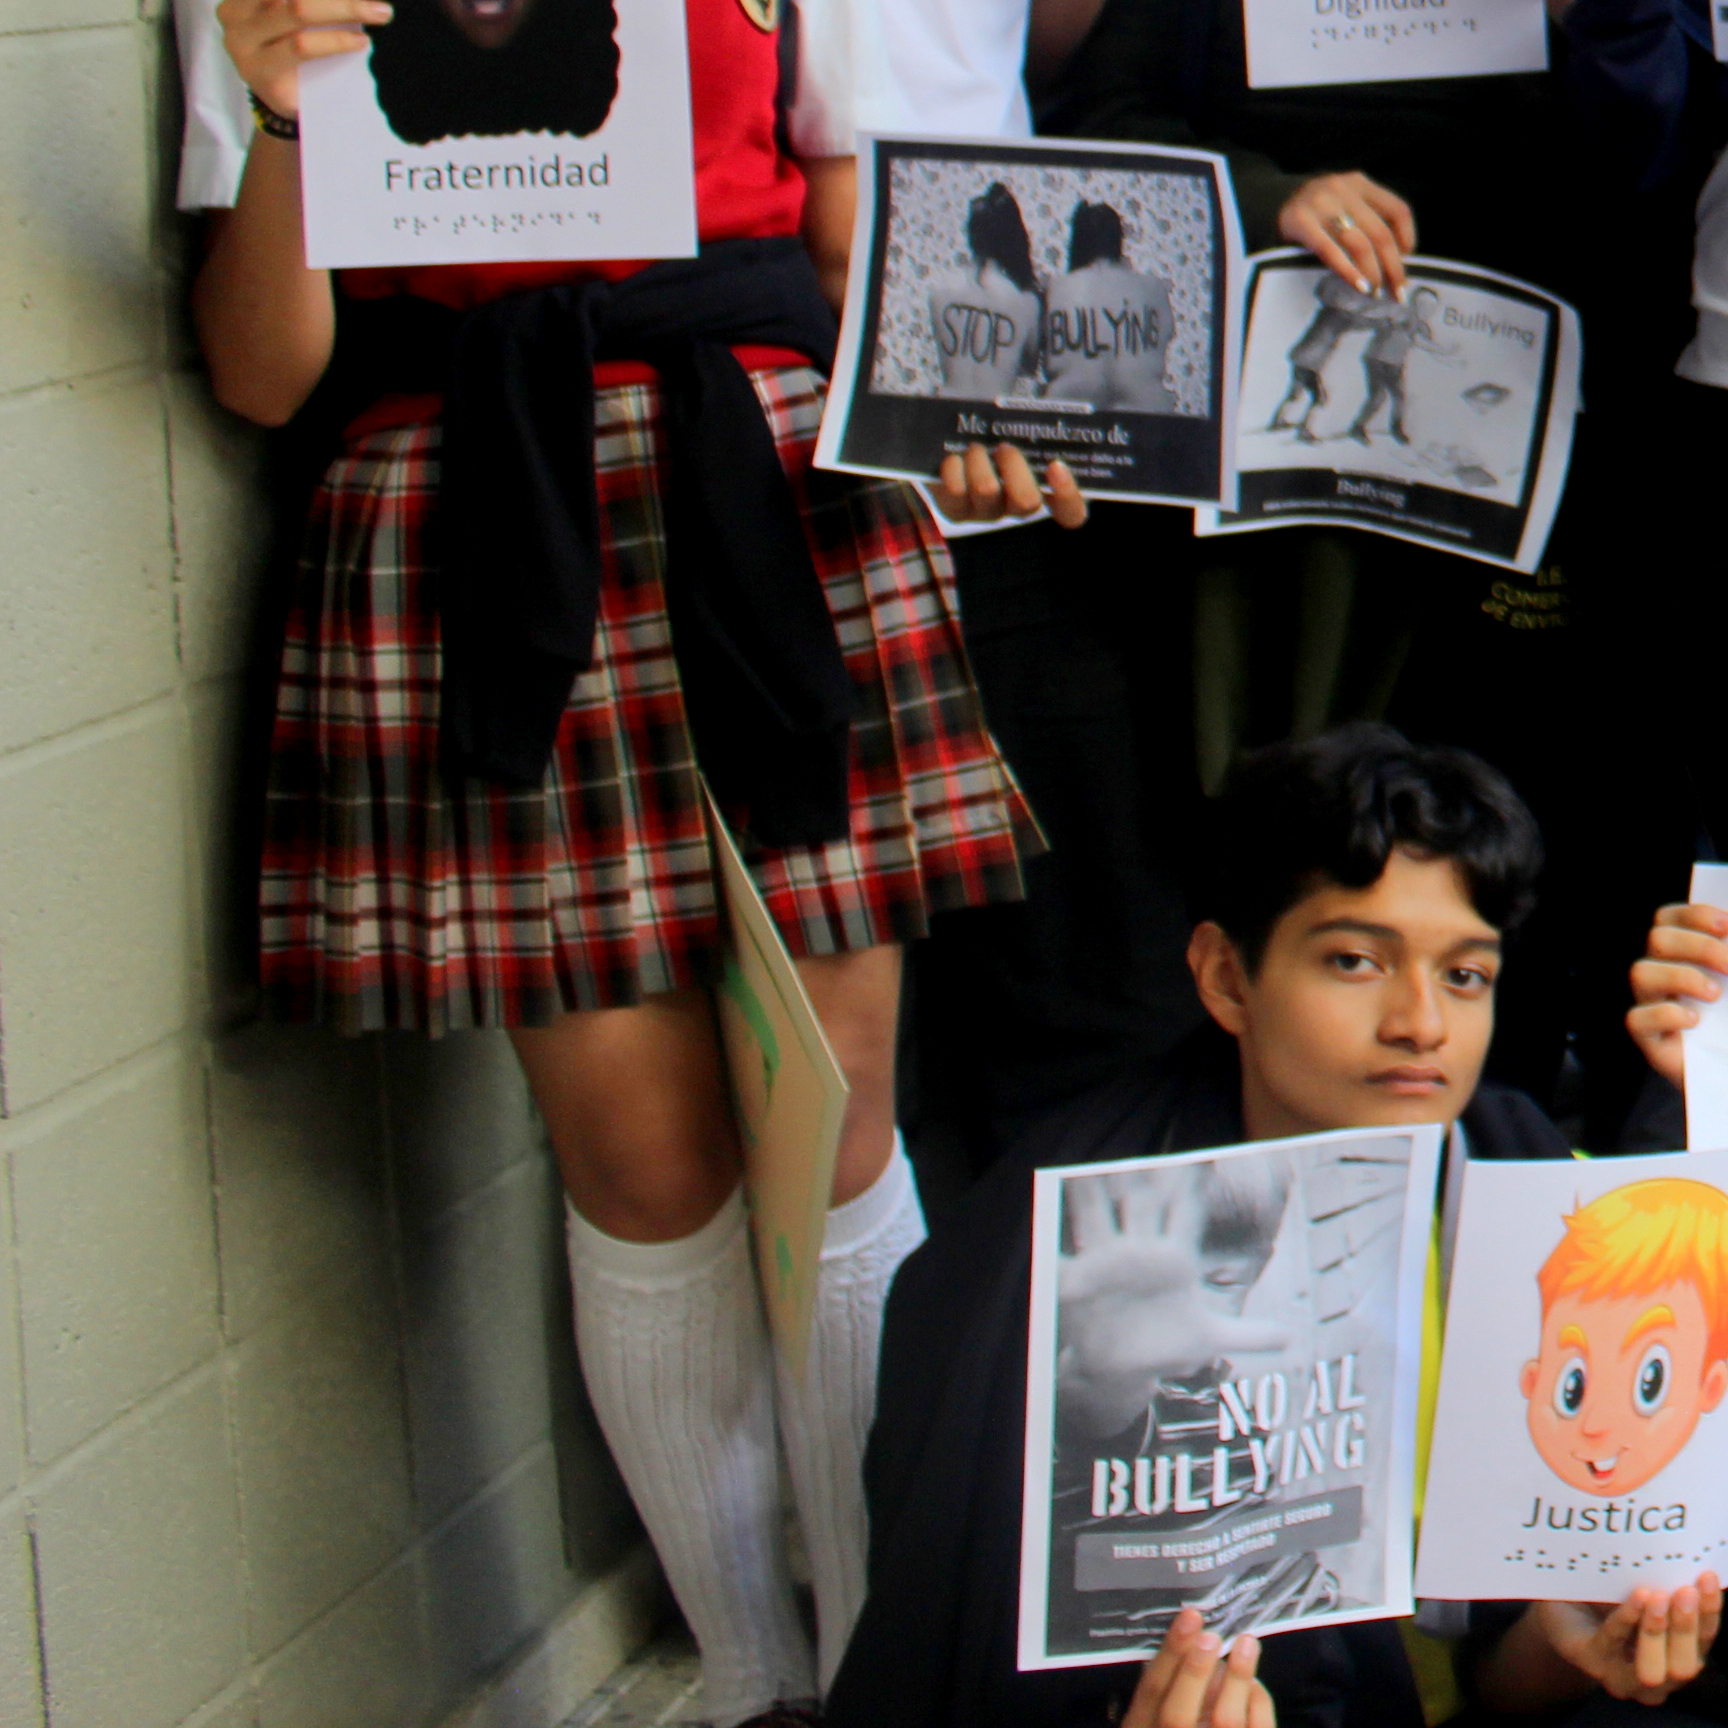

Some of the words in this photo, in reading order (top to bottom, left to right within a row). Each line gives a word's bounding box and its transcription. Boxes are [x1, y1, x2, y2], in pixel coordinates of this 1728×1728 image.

[384, 153, 611, 192] Fraternidad
[941, 301, 1017, 368] STOP
[1049, 298, 1161, 360] BULLYING
[1442, 305, 1537, 349] Bullying
[956, 412, 988, 436] Me
[991, 416, 1105, 444] compadezco
[1107, 423, 1132, 447] de
[1336, 478, 1407, 509] Bullying
[1218, 1372, 1289, 1442] NO
[1303, 1352, 1367, 1421] AL
[1091, 1411, 1366, 1518] BULLYING
[1112, 1543, 1161, 1559] TIENES
[1161, 1535, 1222, 1558] DERECHO
[1284, 1502, 1334, 1526] SEGURO
[1521, 1495, 1688, 1534] Justica
[1176, 1560, 1187, 1573] Y
[1188, 1556, 1215, 1573] SER
